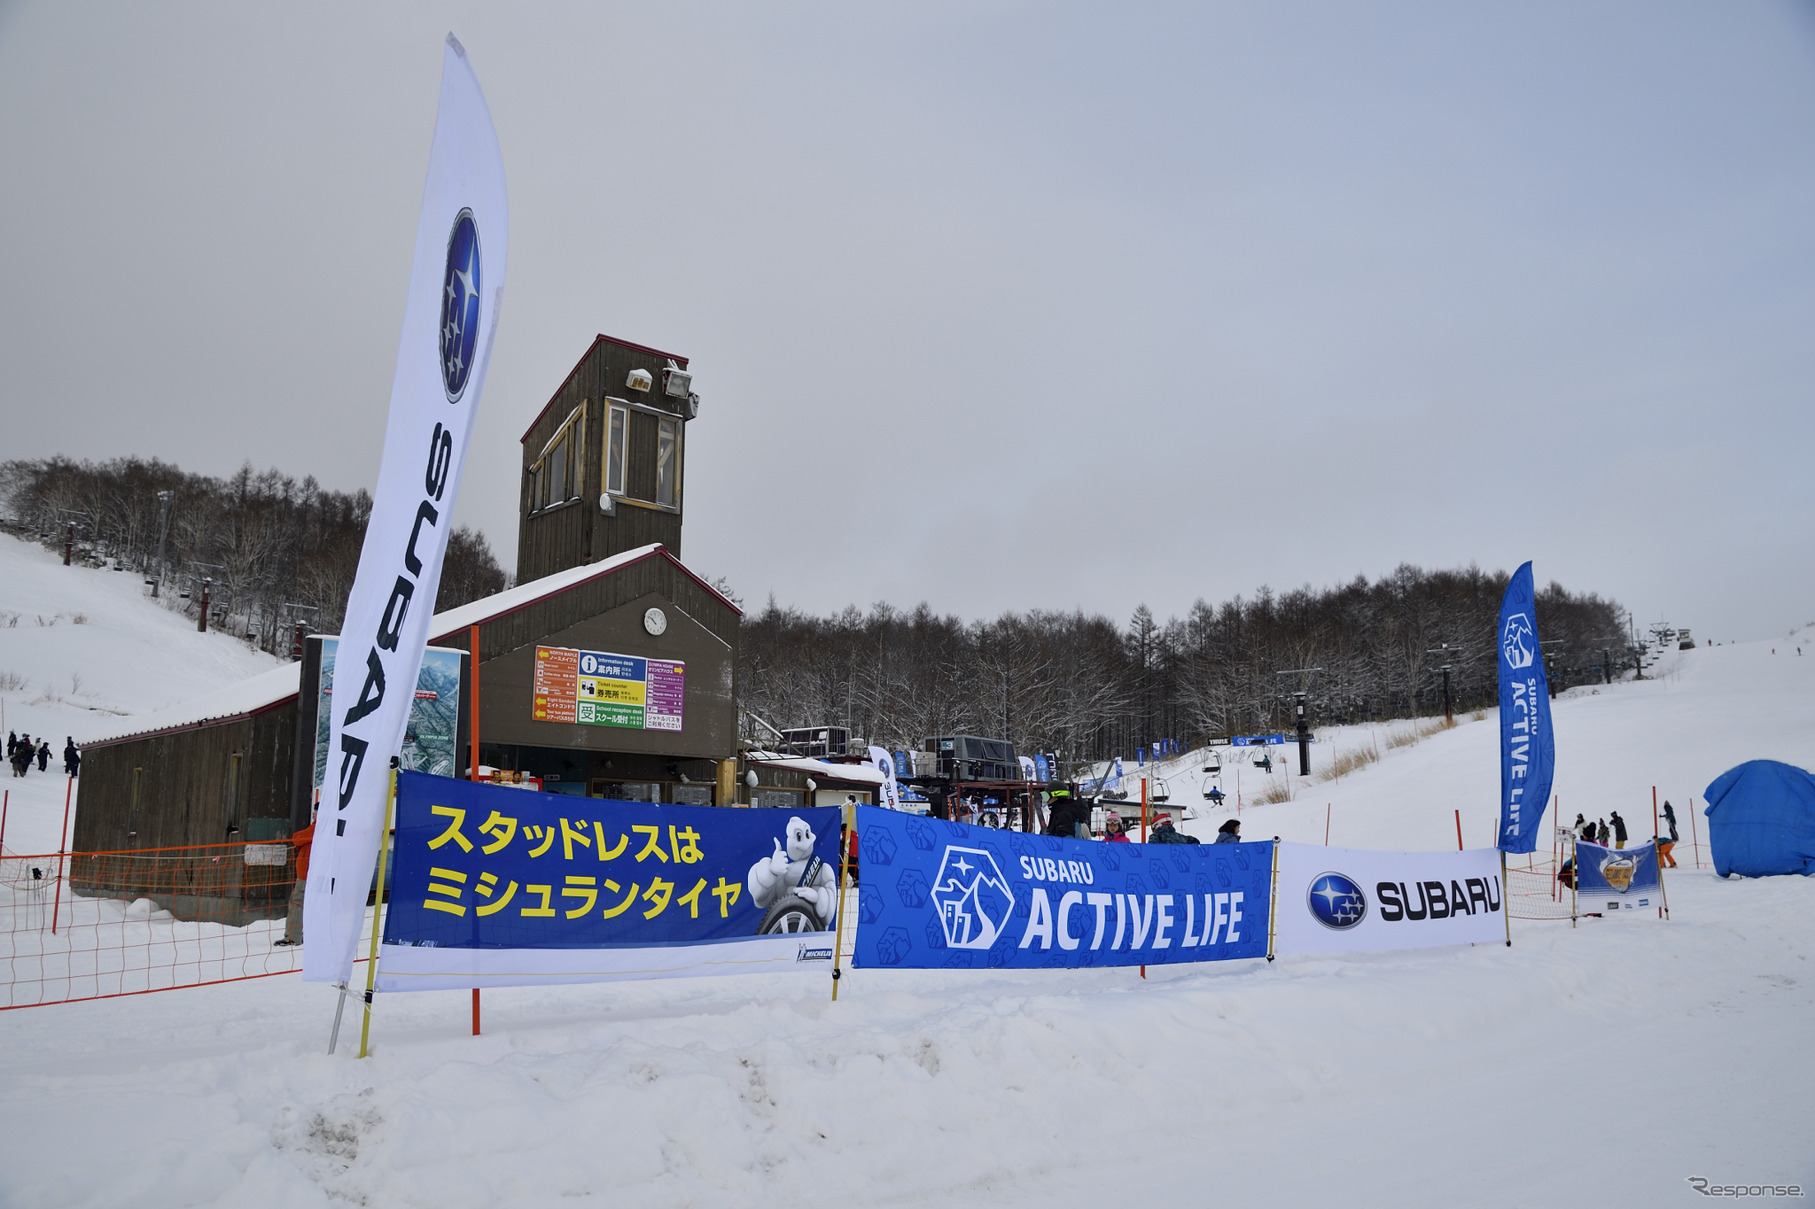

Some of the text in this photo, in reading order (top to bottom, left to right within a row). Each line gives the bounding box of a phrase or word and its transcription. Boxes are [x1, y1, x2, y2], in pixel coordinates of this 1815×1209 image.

[598, 665, 620, 675] 案内所
[582, 706, 593, 720] 受
[597, 690, 619, 699] 券売所
[1527, 678, 1537, 736] SUBARU
[596, 714, 628, 724] スクール受付
[648, 715, 680, 723] シャトルバスを
[1511, 682, 1530, 780] ACTIVE
[427, 805, 704, 864] スタッドレスは
[1020, 856, 1094, 884] SUBARU
[423, 867, 742, 920] ミシュランタイヤ
[1376, 876, 1501, 922] SUBARU
[1018, 888, 1244, 950] ACTIVE LIFE
